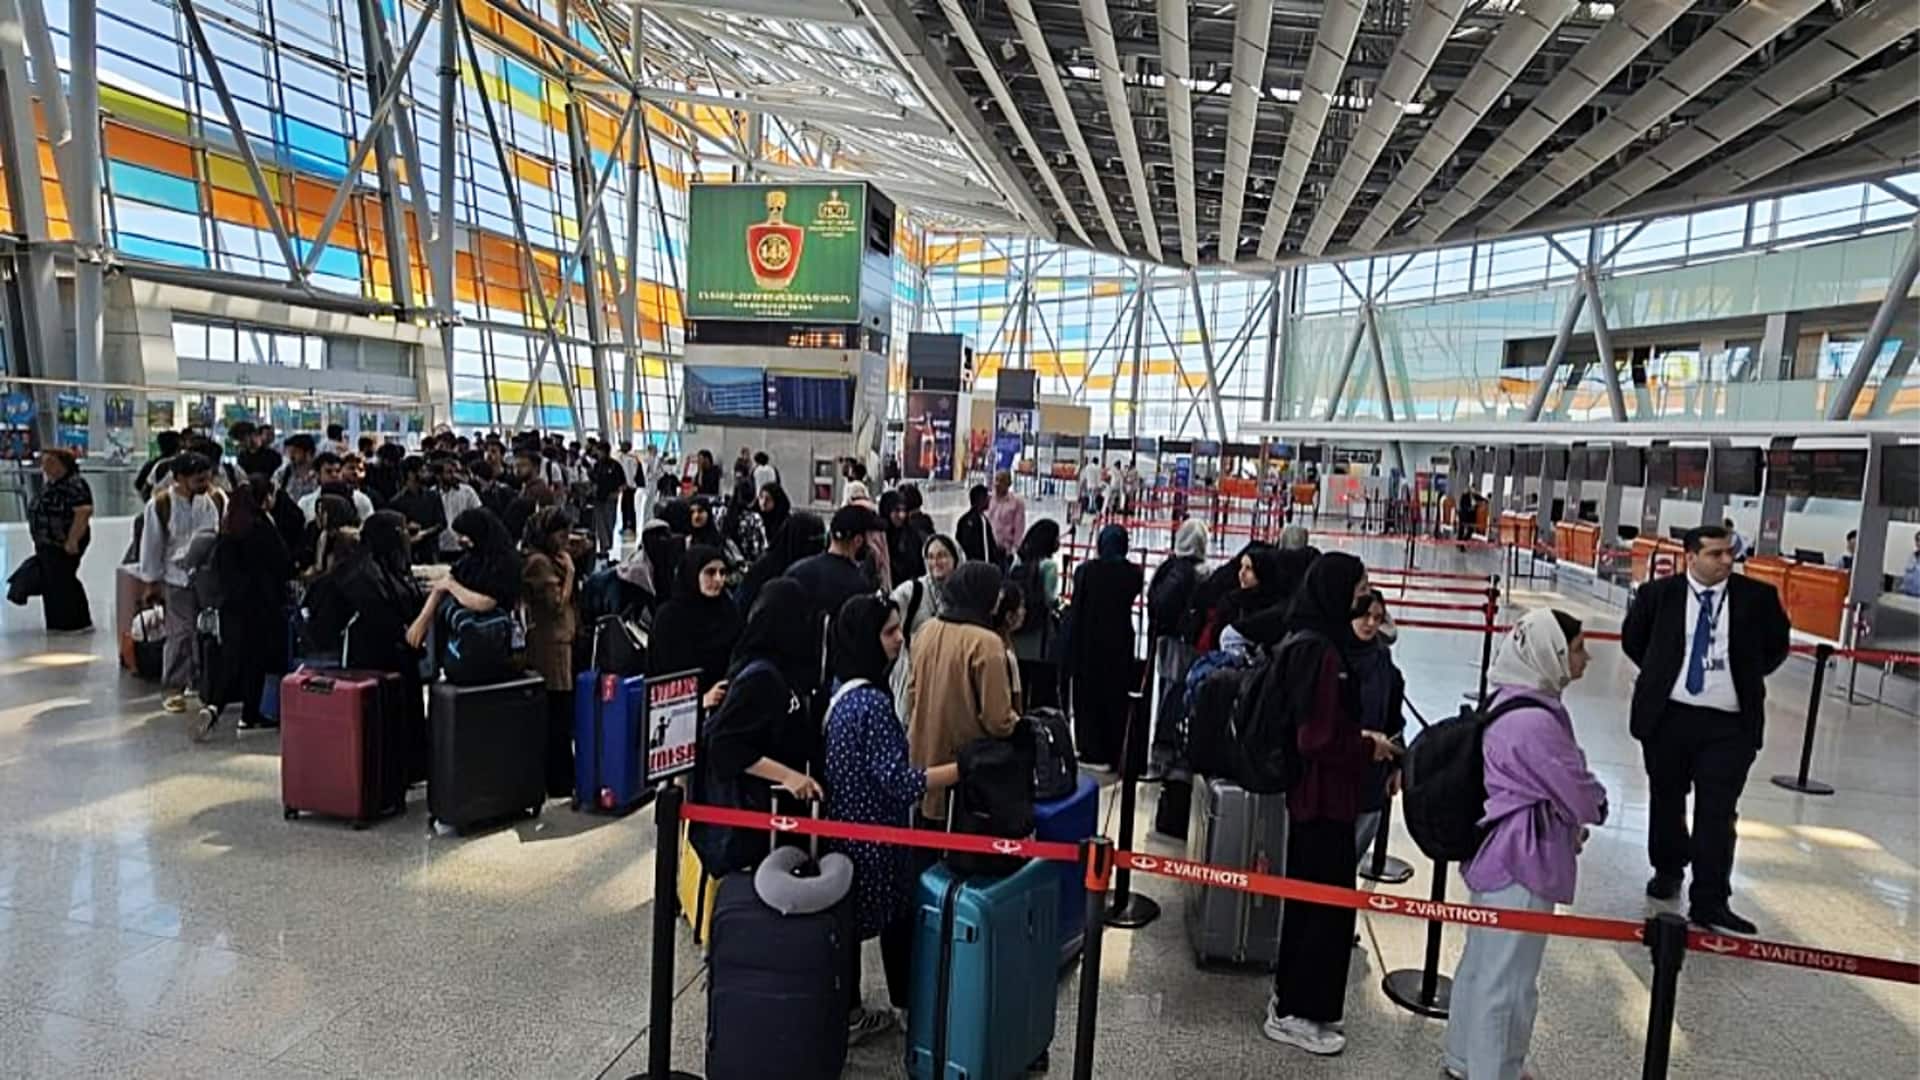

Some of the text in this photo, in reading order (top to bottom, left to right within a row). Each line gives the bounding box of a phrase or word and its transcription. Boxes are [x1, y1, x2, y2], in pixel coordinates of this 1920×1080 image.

[1163, 860, 1248, 887] ZVARTNOTS
[1404, 900, 1498, 924] ZVARTNOTS
[1749, 943, 1857, 972] ZVARTNOTS
